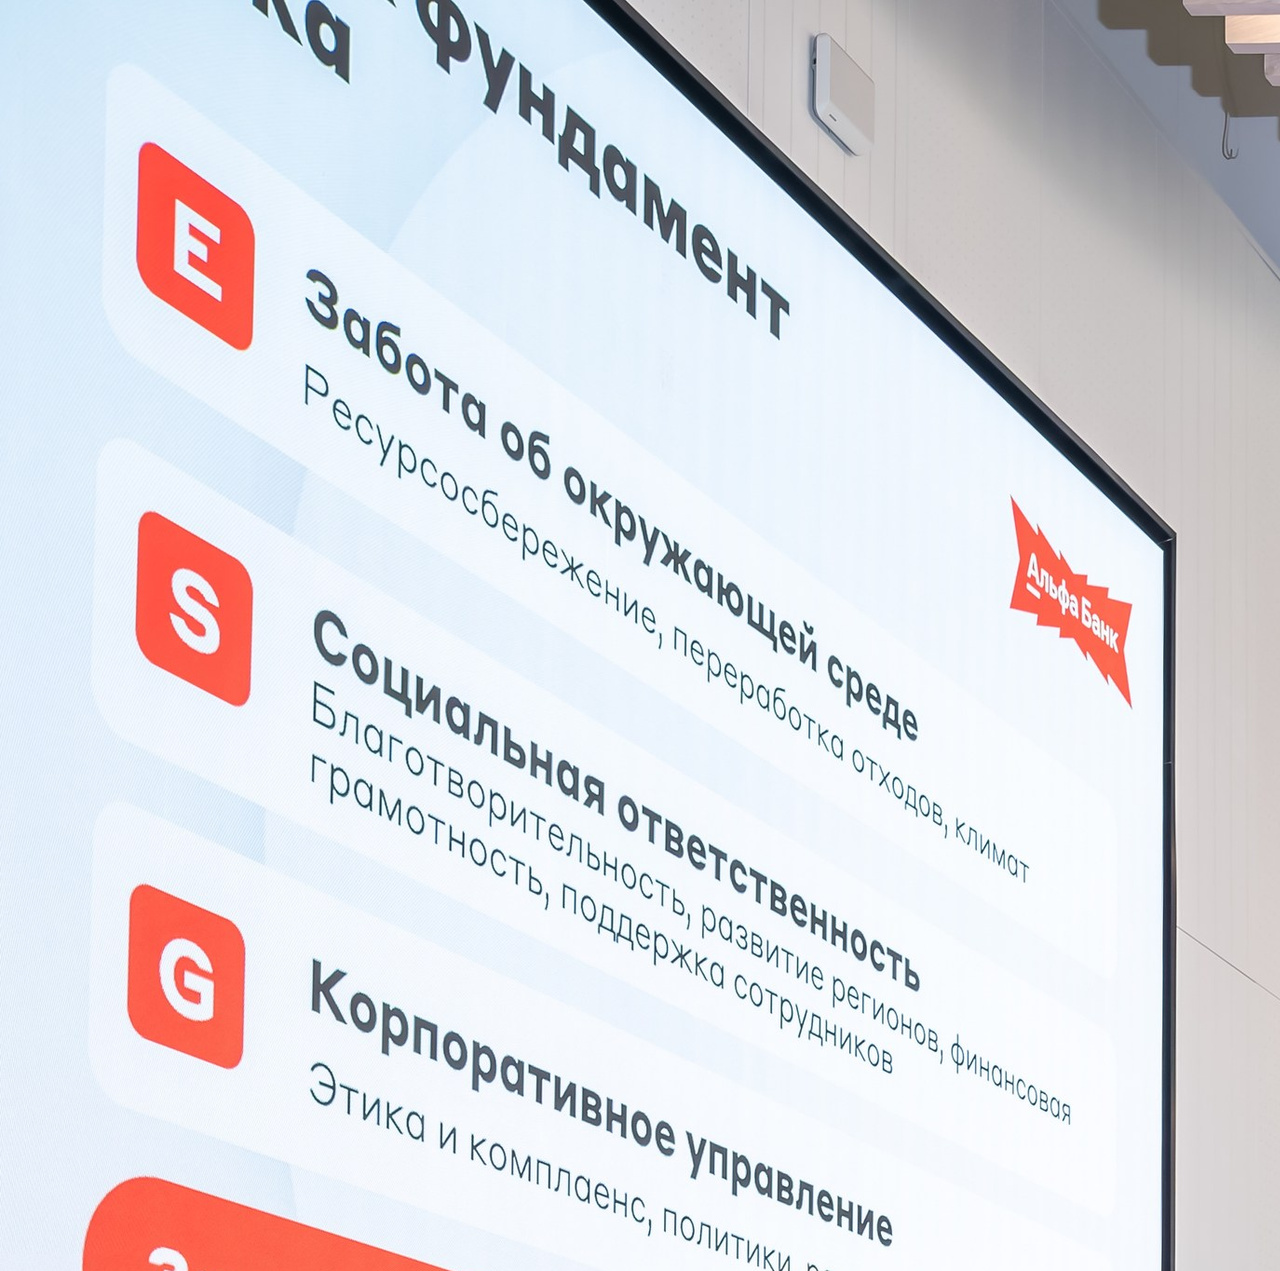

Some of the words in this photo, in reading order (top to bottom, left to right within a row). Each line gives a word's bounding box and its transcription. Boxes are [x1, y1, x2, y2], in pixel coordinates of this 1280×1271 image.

[173, 198, 223, 301] E
[415, 0, 790, 341] фундамент
[168, 567, 220, 655] S
[304, 268, 486, 440] Забота
[500, 421, 551, 481] об
[563, 466, 817, 673] окружающей
[827, 654, 919, 742] среде
[304, 363, 663, 650] Ресурсосбережение,
[673, 626, 844, 761] переработка
[852, 749, 948, 839] отходов,
[955, 817, 1030, 883] климат
[1027, 552, 1079, 616] Альфа
[1081, 596, 1119, 654] Банк
[310, 752, 549, 911] грамотность,
[562, 883, 725, 990] поддержка
[734, 974, 893, 1074] сотрудников
[312, 608, 605, 817] Социальная
[617, 794, 920, 992] ответственность
[312, 680, 691, 931] Благотворительность,
[701, 904, 824, 991] развитие
[832, 976, 944, 1065] регионов,
[950, 1033, 1071, 1125] финансовая
[158, 937, 215, 1021] G
[311, 958, 676, 1157] Корпоративное
[685, 1130, 893, 1247] управление
[309, 1062, 425, 1143] Этика
[439, 1121, 457, 1155] и
[470, 1133, 652, 1237] комплаенс,
